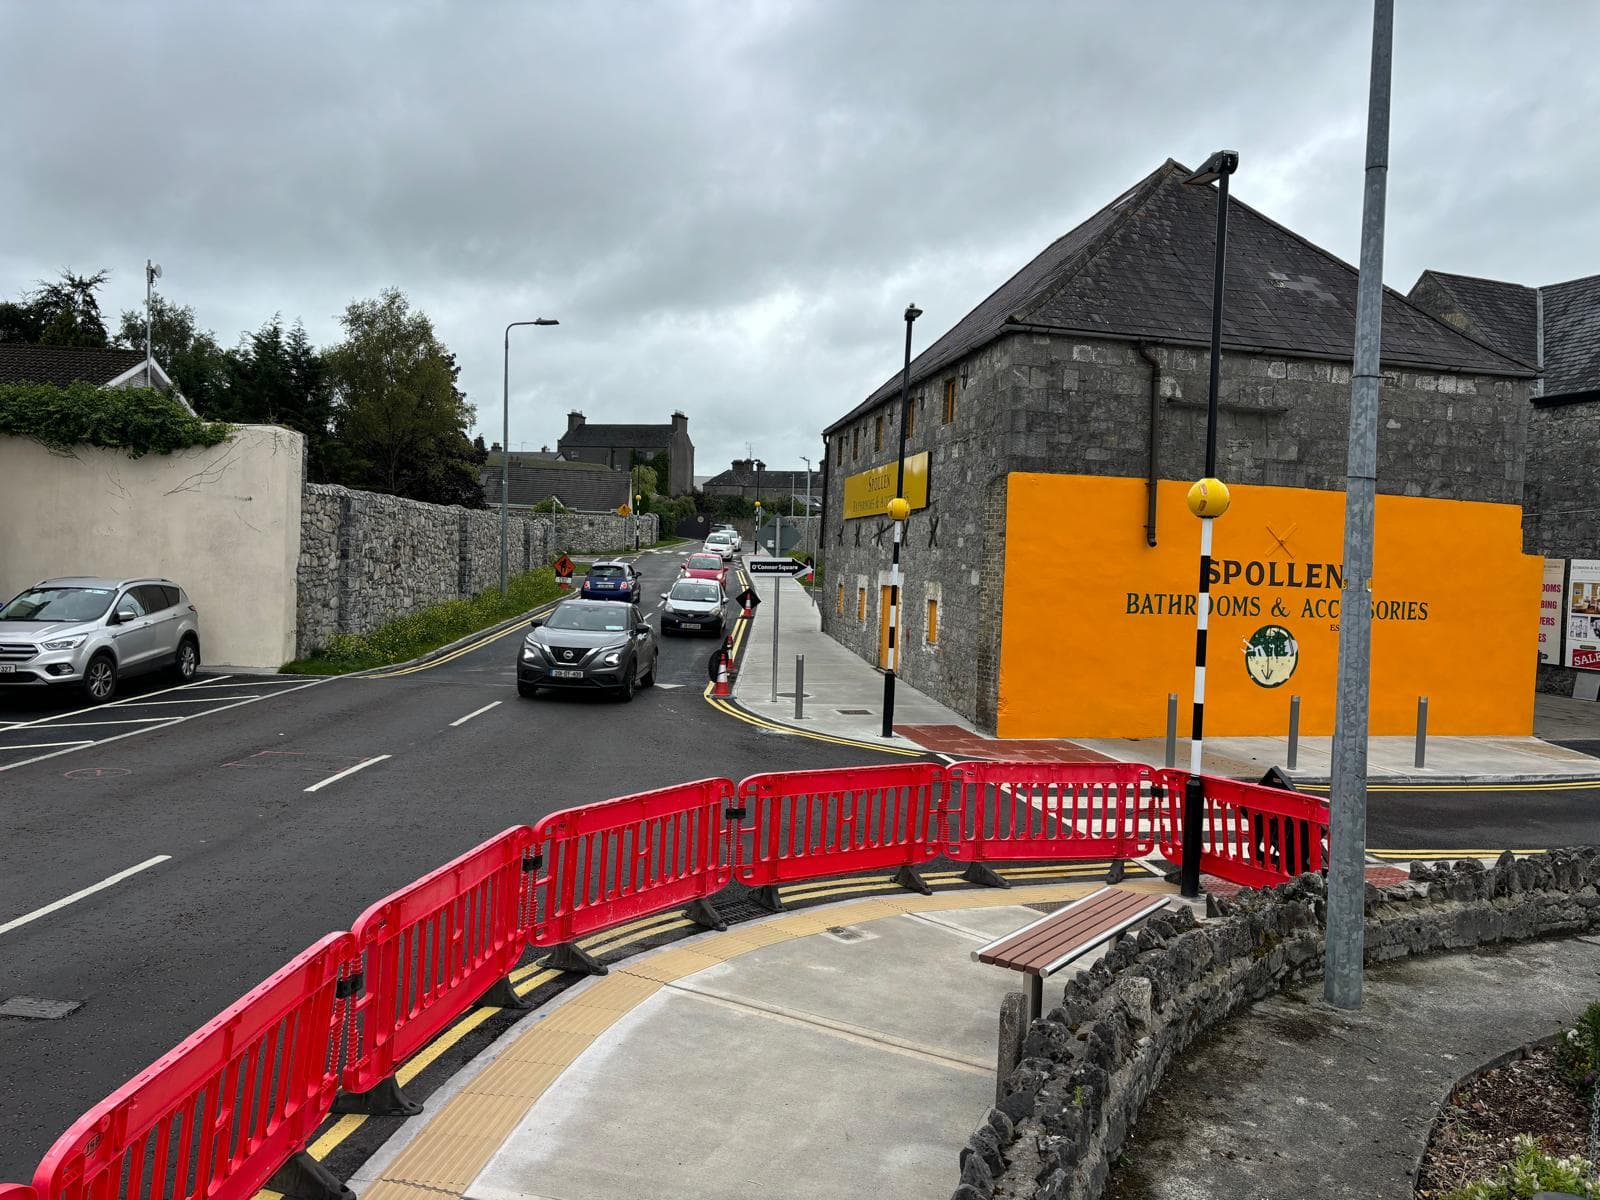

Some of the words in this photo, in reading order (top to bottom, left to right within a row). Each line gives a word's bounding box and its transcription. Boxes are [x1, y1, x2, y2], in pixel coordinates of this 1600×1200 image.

[779, 564, 798, 572] Square
[1208, 559, 1343, 588] SPOLLEN
[1270, 597, 1290, 617] &
[1301, 598, 1428, 620] ACCORIES
